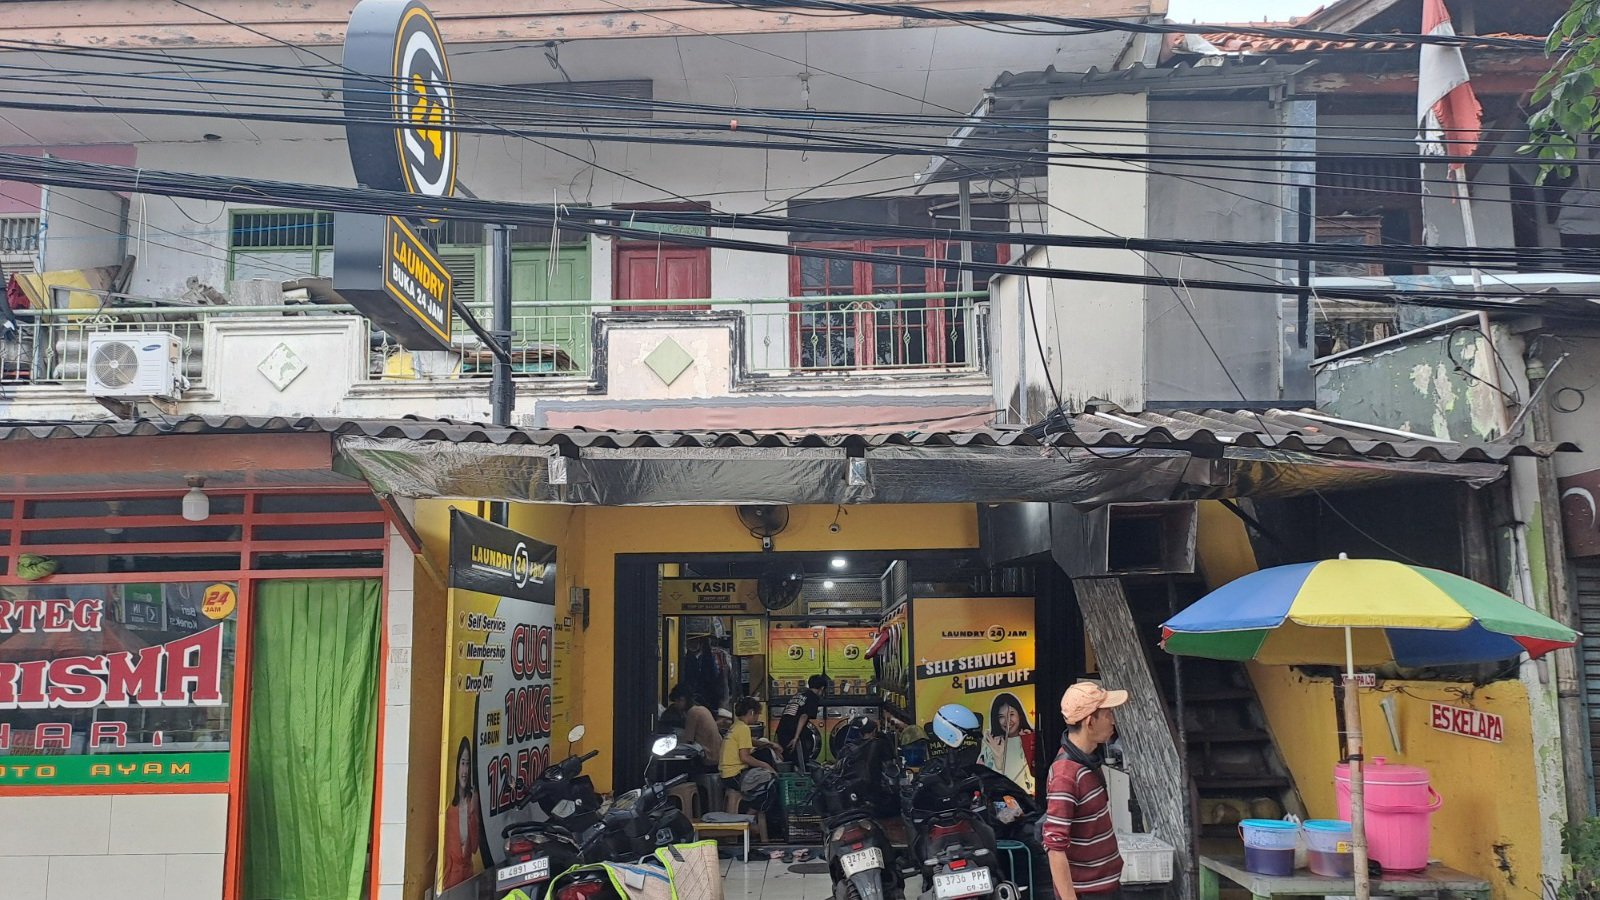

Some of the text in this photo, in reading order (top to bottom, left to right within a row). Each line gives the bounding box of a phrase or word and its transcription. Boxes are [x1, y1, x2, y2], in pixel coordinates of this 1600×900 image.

[392, 231, 445, 302] LAUNDRY
[392, 261, 444, 325] BUKA 24 JAM
[471, 544, 513, 571] LAUNDRY
[516, 555, 526, 575] 24
[692, 582, 736, 592] KASIR
[205, 590, 230, 606] 24
[467, 613, 506, 631] Self Service
[466, 643, 506, 660] Membership
[511, 623, 552, 680] CUCI
[789, 649, 801, 657] 24
[925, 650, 1014, 675] SELF SERVICE
[465, 674, 494, 693] Drop Off
[951, 668, 1030, 690] & DROP OFF
[486, 712, 500, 727] FREE
[505, 684, 552, 745] 10KG
[1432, 704, 1503, 741] ES KELAPA
[479, 730, 500, 746] SABUN
[0, 762, 191, 777] TO AYAM
[532, 859, 547, 870] SDB
[937, 870, 987, 887] B 3736 PPF
